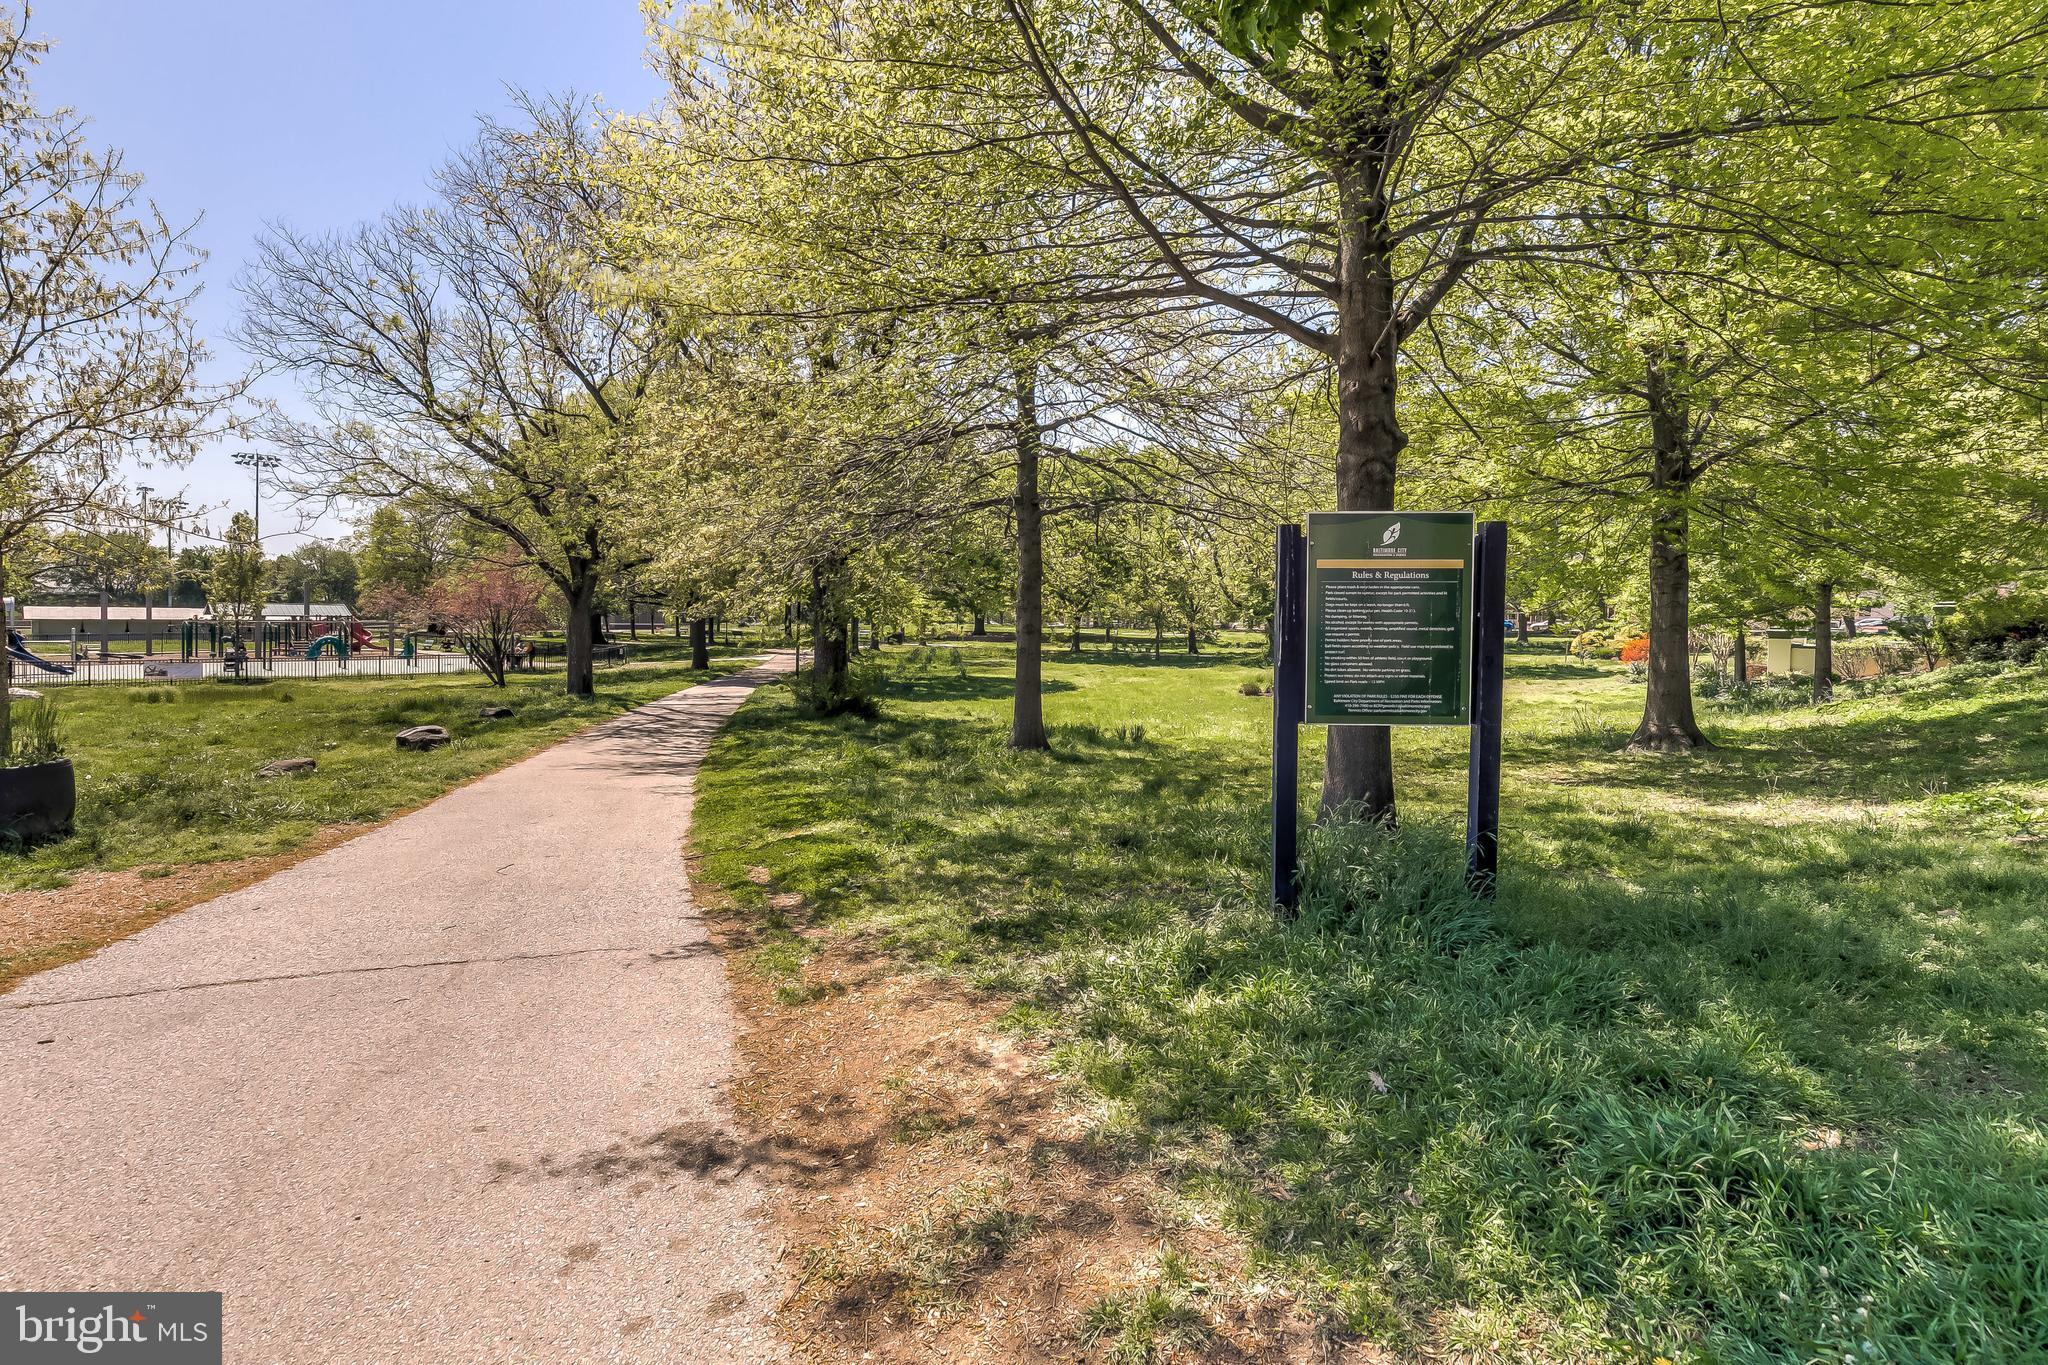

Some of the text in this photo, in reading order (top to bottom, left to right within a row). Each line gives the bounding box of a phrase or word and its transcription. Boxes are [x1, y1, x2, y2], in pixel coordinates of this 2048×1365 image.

[1352, 570, 1430, 581] Rules & Regulations
